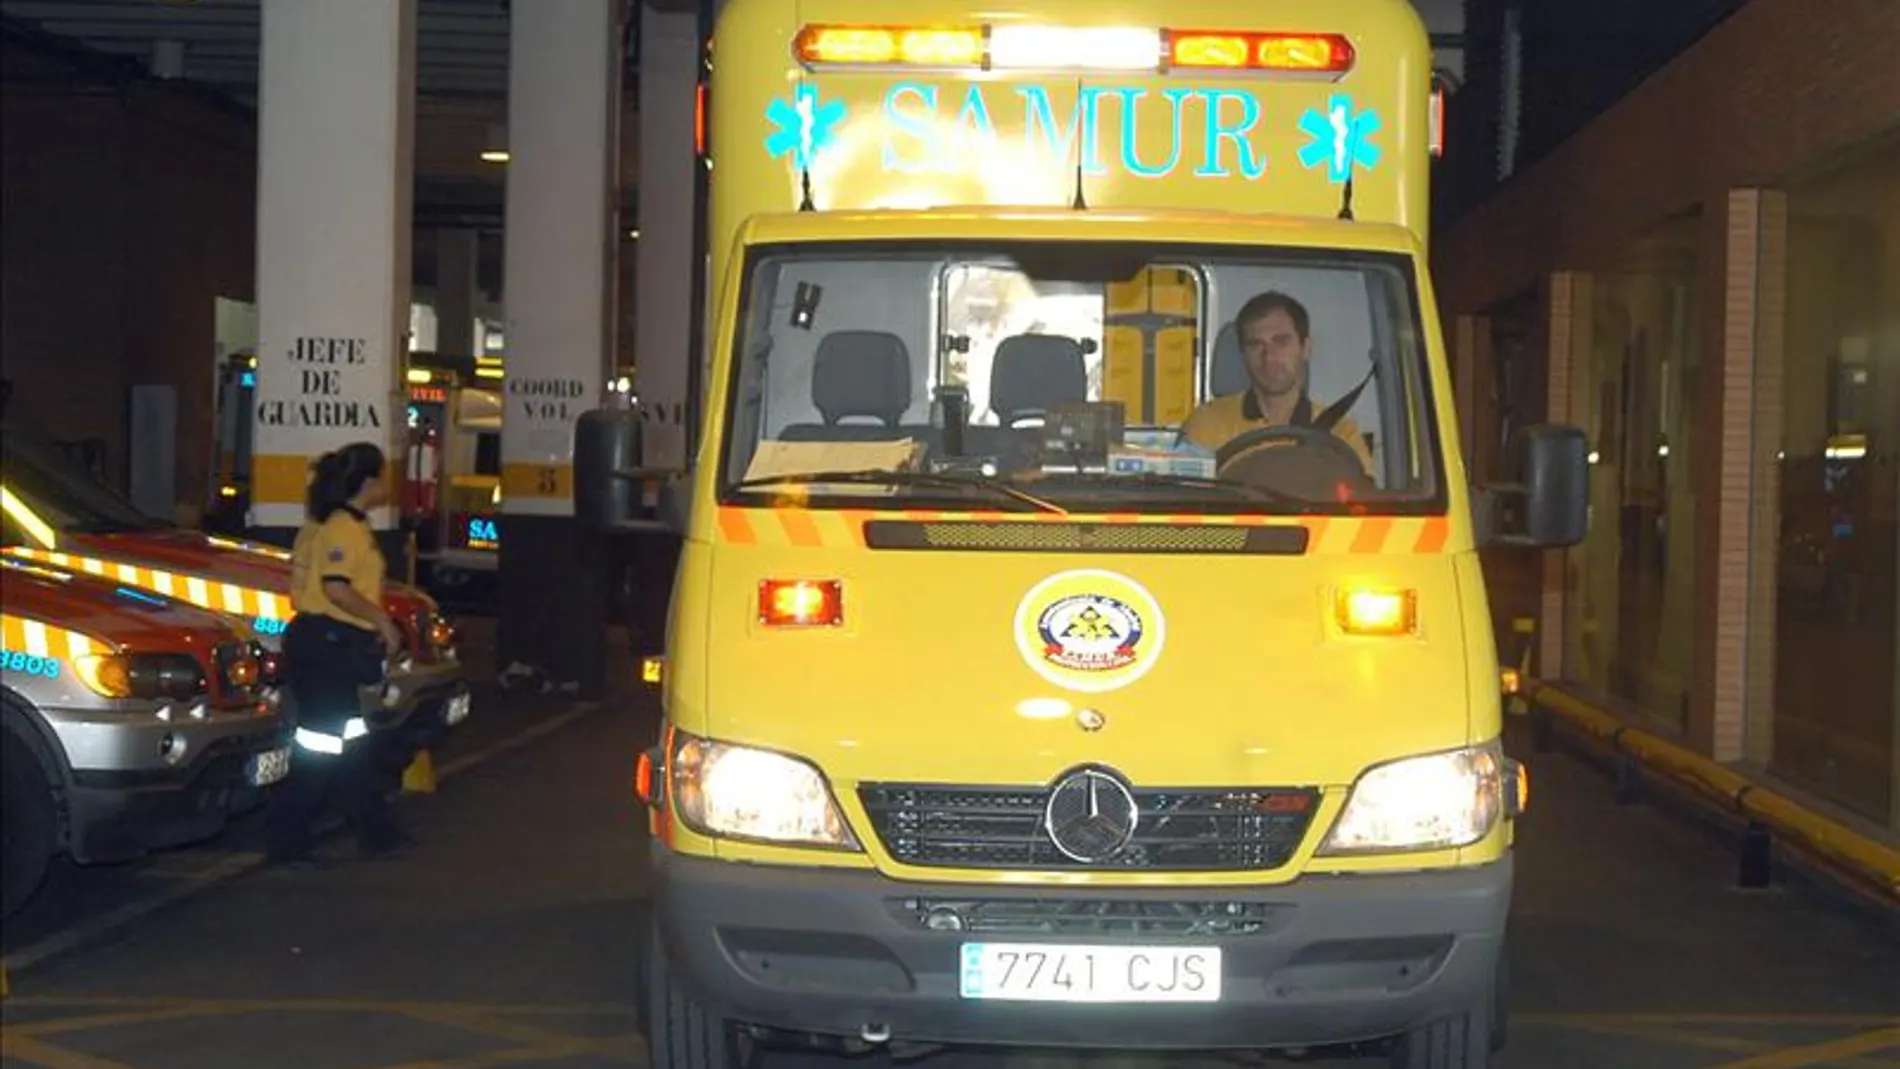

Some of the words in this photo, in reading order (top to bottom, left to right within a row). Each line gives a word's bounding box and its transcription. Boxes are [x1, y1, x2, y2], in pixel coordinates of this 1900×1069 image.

[881, 82, 1266, 179] SAMUR
[287, 336, 366, 365] JEFE
[301, 369, 342, 395] DE
[510, 377, 583, 398] COORD
[258, 401, 381, 428] GUARDIA
[522, 402, 573, 422] VOL
[997, 952, 1094, 991] 7741
[1127, 953, 1206, 992] CJS
